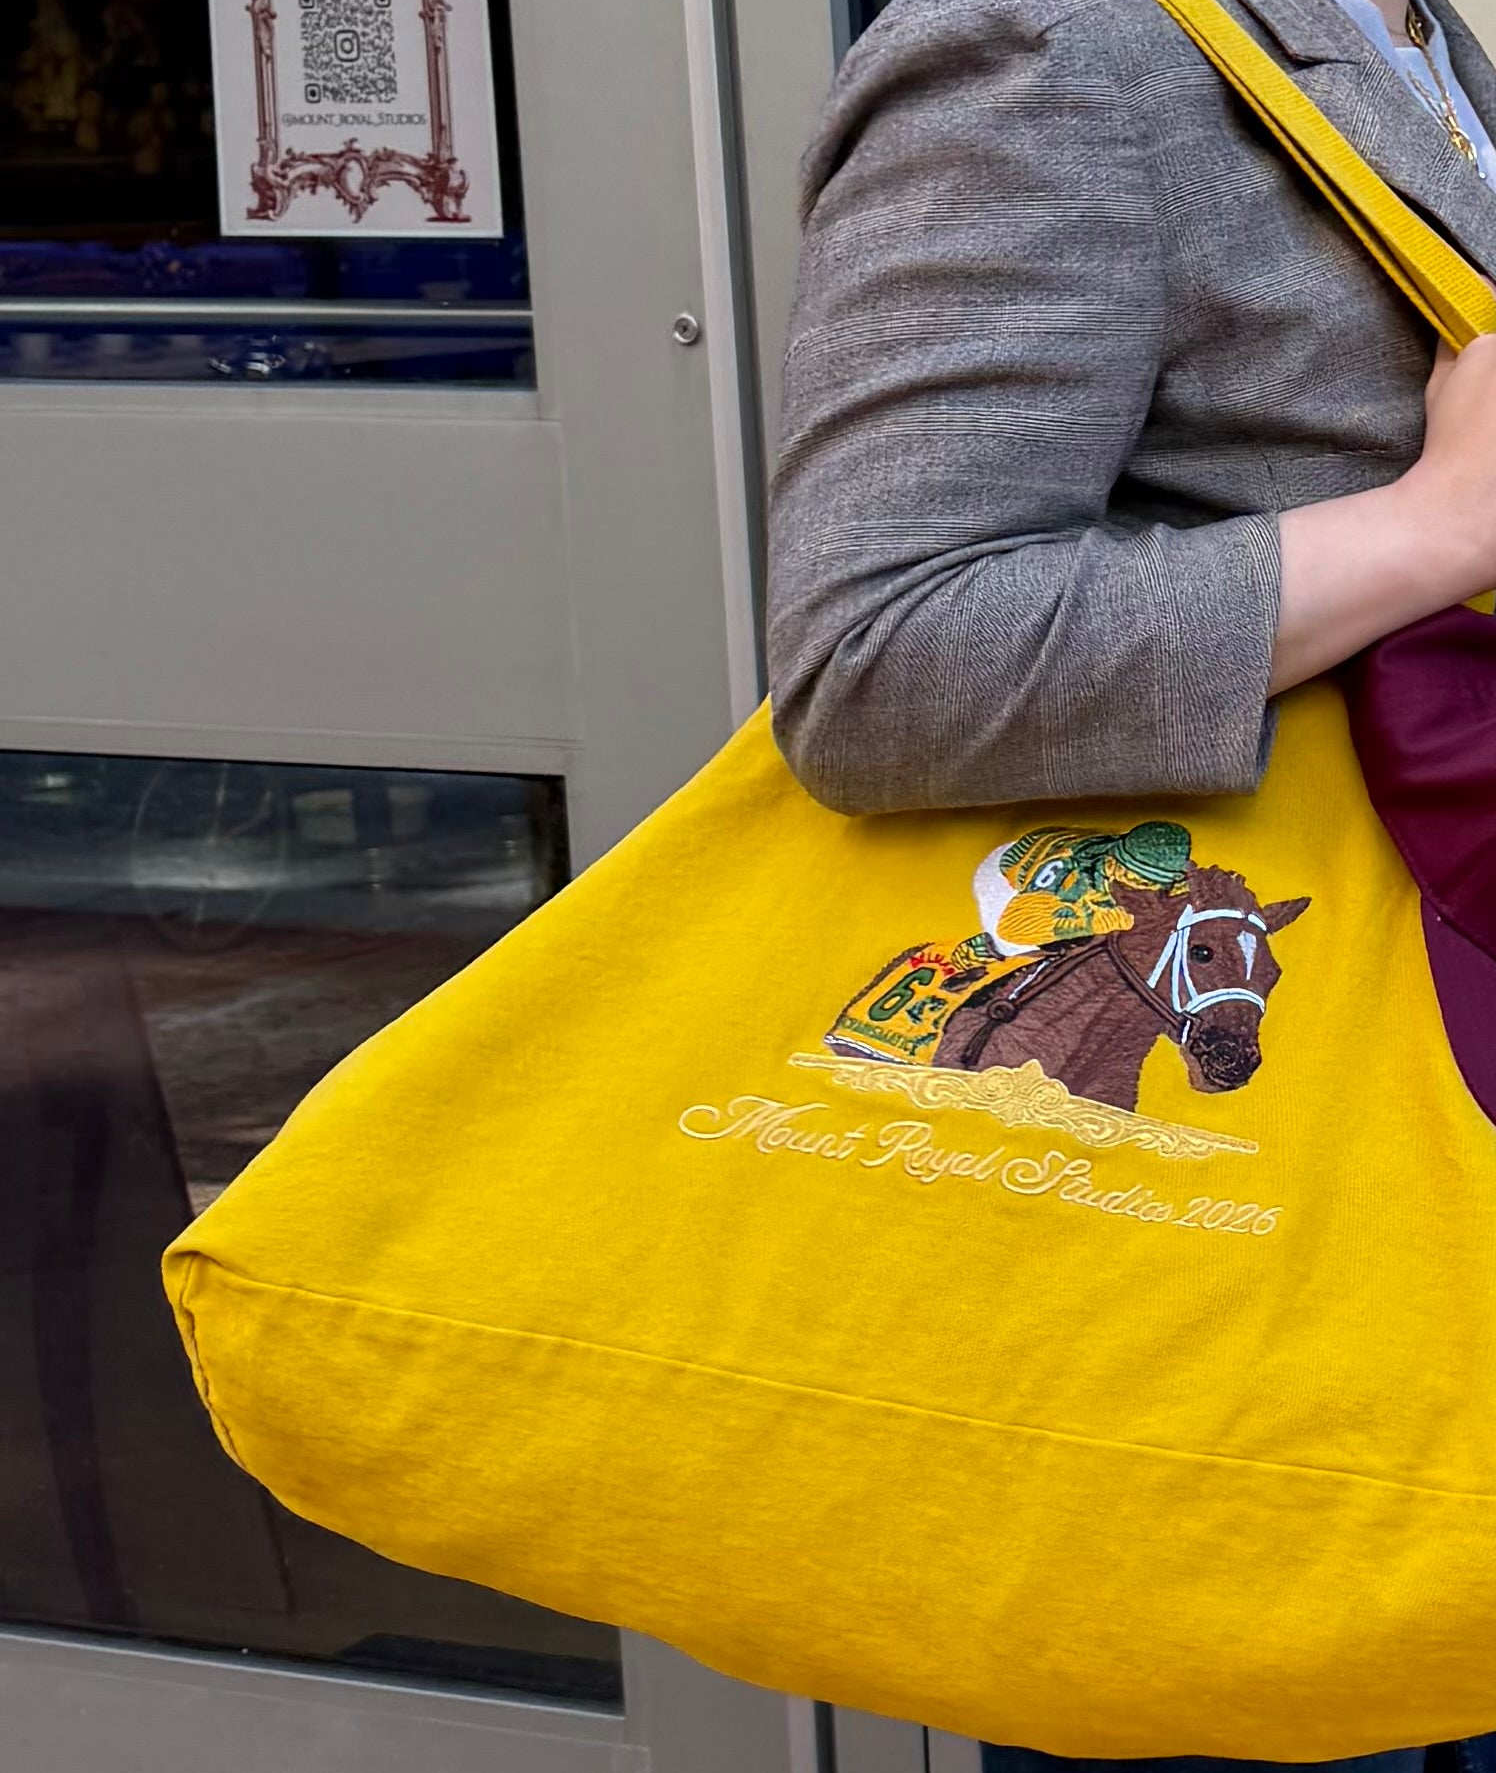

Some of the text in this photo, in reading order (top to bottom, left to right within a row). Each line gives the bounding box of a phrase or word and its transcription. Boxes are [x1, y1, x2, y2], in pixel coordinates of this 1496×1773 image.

[1035, 860, 1064, 888] 6
[868, 966, 936, 1021] 6
[678, 1094, 1284, 1236] Mount Royal Studios 2026
